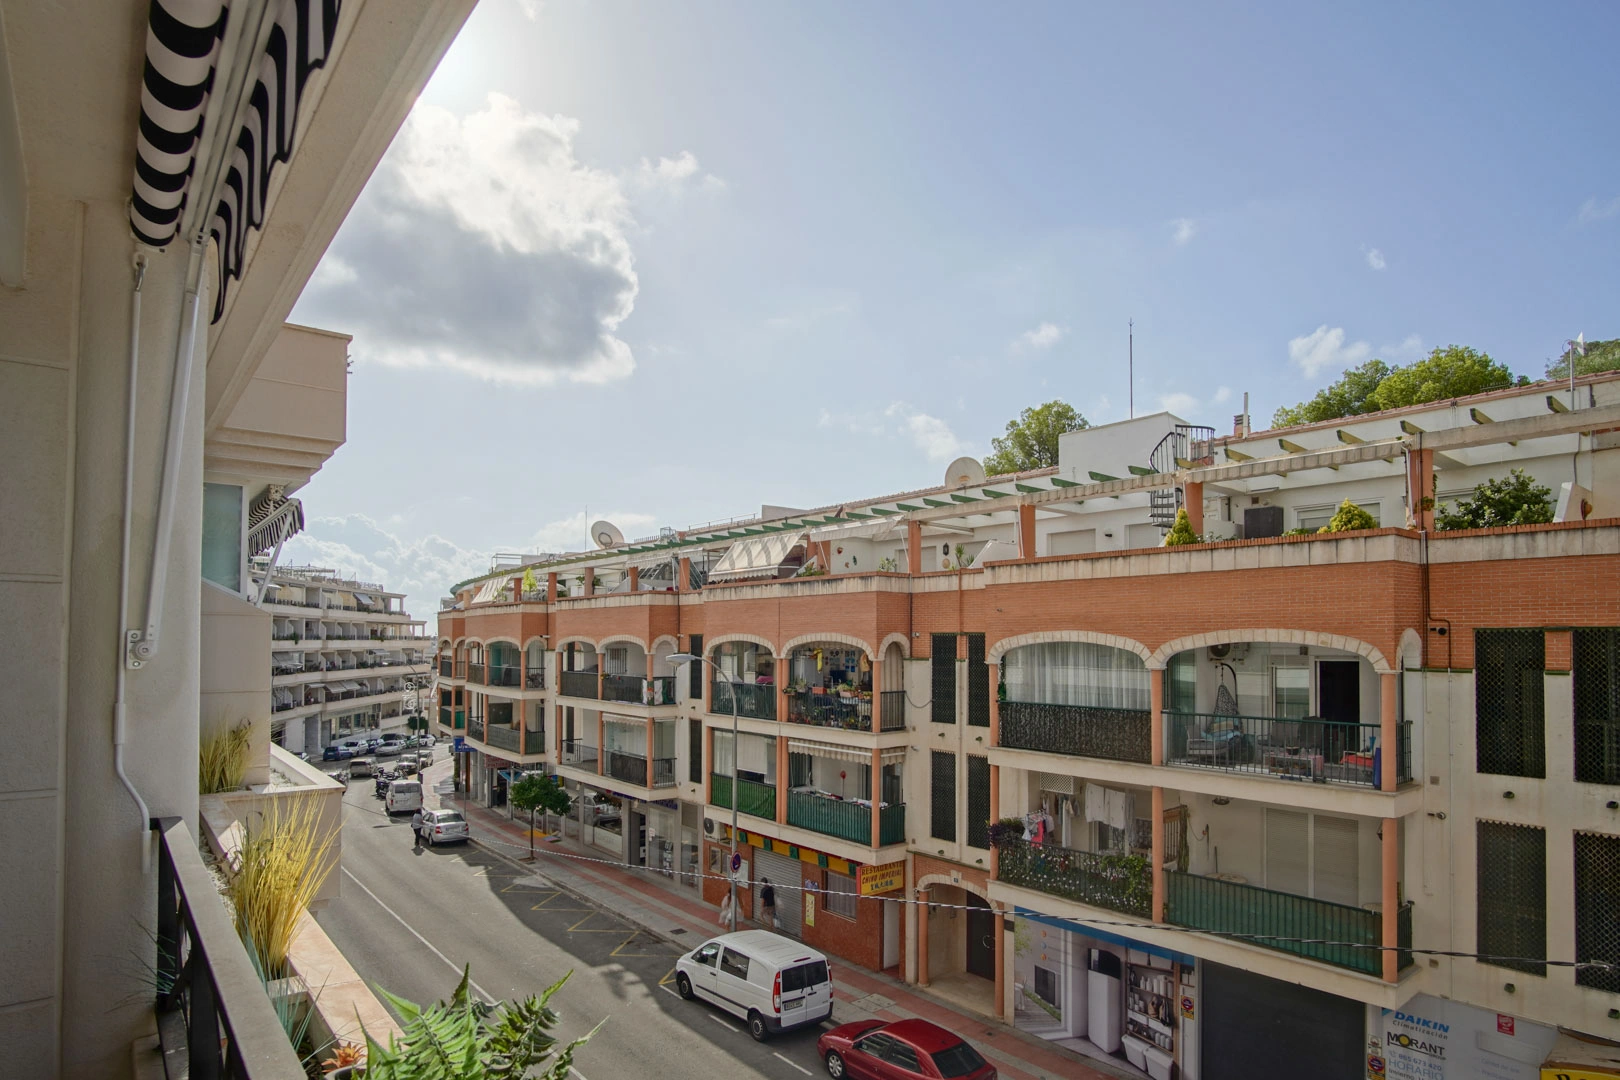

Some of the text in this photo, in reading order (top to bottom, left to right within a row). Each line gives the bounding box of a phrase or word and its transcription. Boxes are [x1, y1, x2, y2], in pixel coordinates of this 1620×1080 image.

[862, 862, 902, 875] RESTAURANTE
[862, 869, 901, 884] CHINO IMPERIAL
[1392, 1020, 1449, 1040] Climatización
[1394, 1011, 1450, 1033] DAIKIN
[1387, 1031, 1445, 1056] MORANT
[1388, 1058, 1444, 1080] HORARIO
[1428, 1063, 1442, 1072] 420
